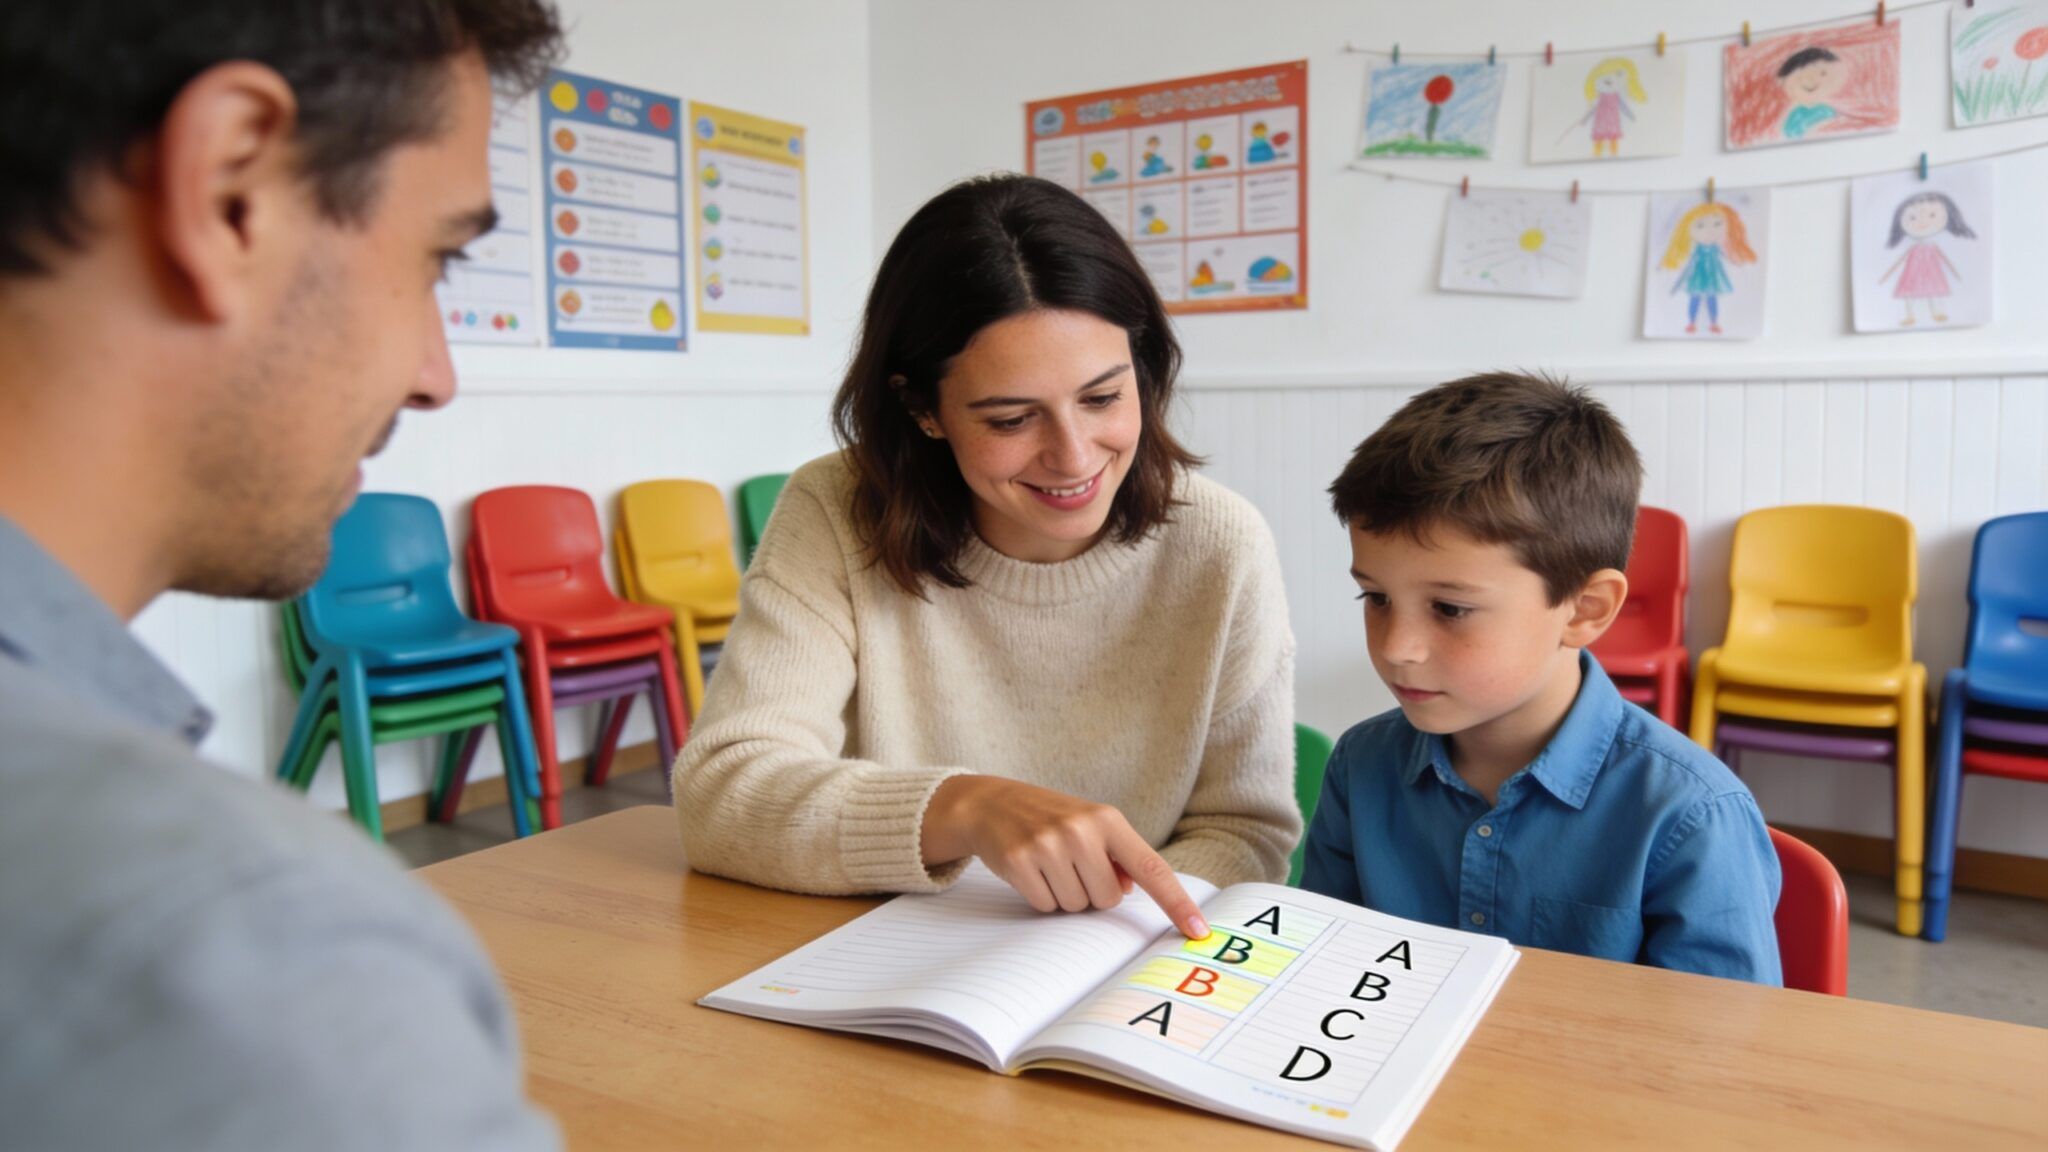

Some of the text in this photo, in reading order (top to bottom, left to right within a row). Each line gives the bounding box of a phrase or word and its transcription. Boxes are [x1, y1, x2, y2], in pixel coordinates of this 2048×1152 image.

[1244, 906, 1280, 935] A
[1213, 936, 1253, 964] B
[1376, 940, 1411, 970] A
[1176, 967, 1219, 996] B
[1350, 971, 1391, 1001] B
[1128, 1001, 1172, 1036] A
[1320, 1009, 1365, 1040] C
[1279, 1046, 1332, 1081] D
